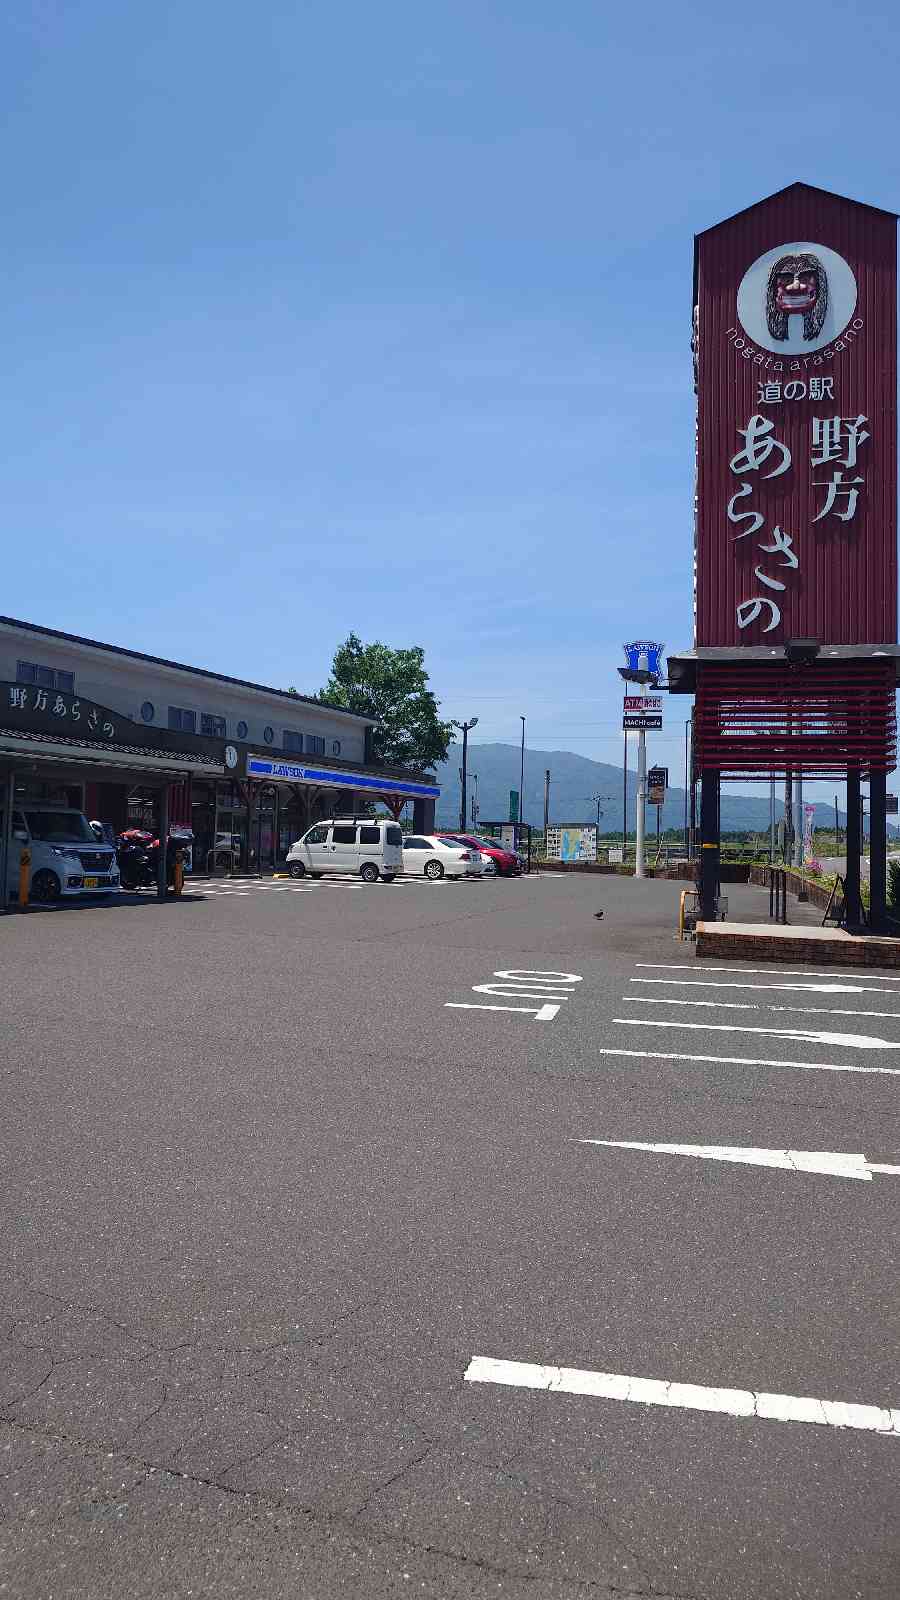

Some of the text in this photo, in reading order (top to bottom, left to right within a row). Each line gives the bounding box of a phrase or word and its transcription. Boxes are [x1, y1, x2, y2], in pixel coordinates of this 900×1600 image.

[725, 316, 865, 372] nogata arasano
[757, 377, 836, 404] 道の駅
[810, 414, 870, 524] 野方
[727, 414, 800, 633] あらさの
[8, 687, 115, 738] 野方あらさの
[624, 719, 646, 727] MACHI
[272, 763, 304, 779] LAWSON
